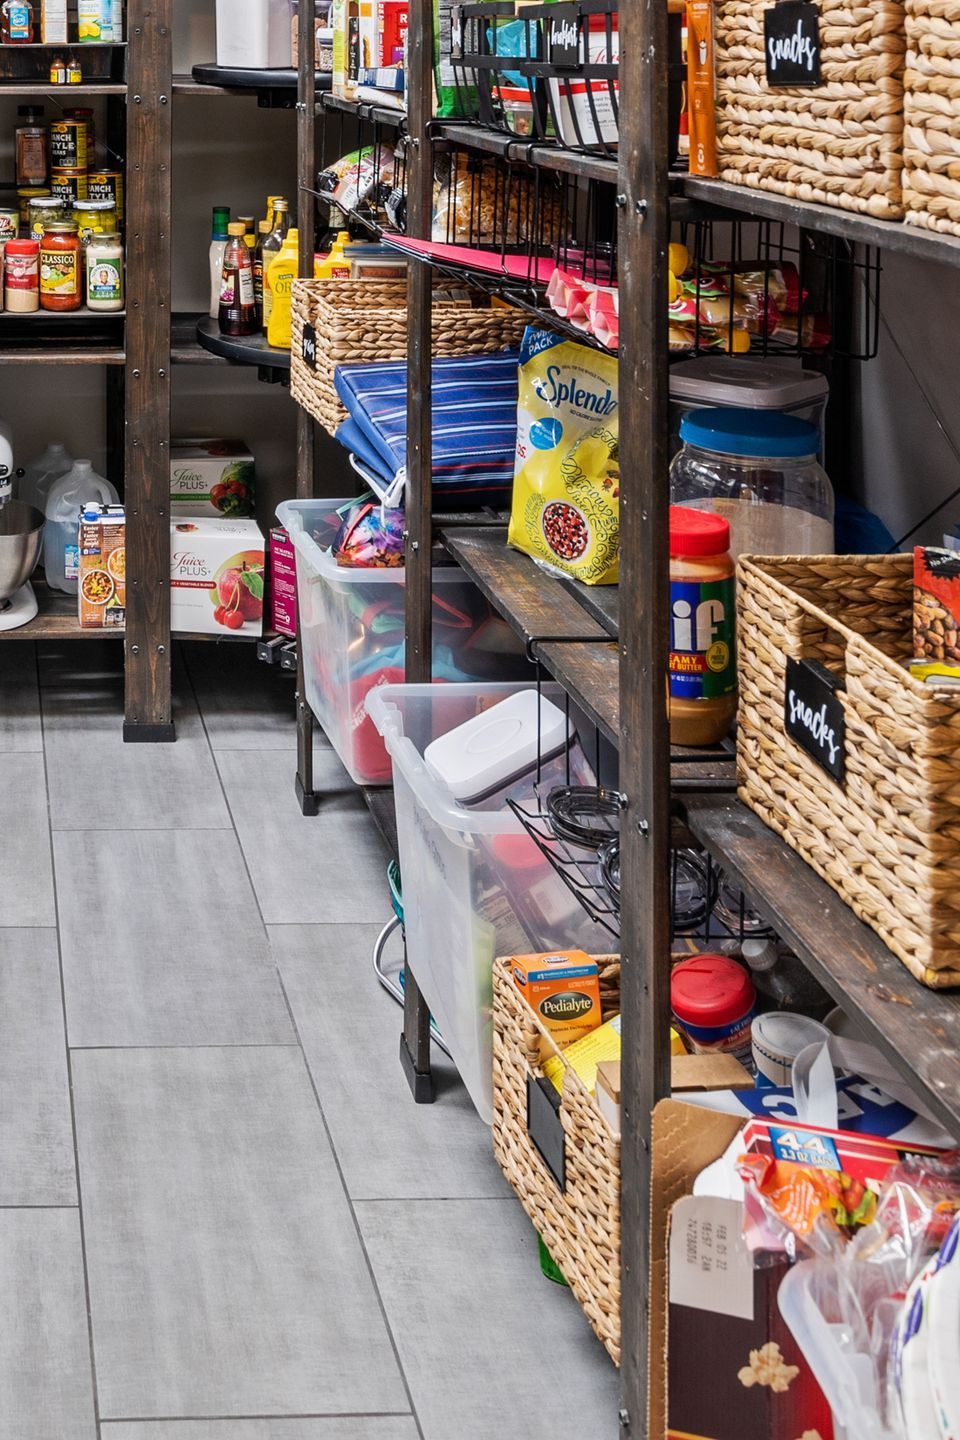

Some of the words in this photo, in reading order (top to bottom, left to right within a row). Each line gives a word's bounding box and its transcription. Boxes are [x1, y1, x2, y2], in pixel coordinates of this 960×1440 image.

[768, 19, 816, 71] snacks
[52, 134, 72, 142] ANCH
[52, 142, 75, 150] TYLE
[52, 186, 73, 194] ANCH
[41, 254, 74, 264] CLASSICO
[528, 335, 554, 356] PACK
[172, 468, 204, 489] Juice
[171, 551, 206, 568] Juice
[672, 600, 726, 651] if
[677, 663, 702, 671] BUTTER
[788, 687, 840, 765] snacks
[543, 998, 592, 1014] Pedialyte
[776, 1131, 828, 1155] 44
[781, 1149, 796, 1160] 3.3
[797, 1150, 808, 1162] OZ
[717, 1224, 727, 1240] FEB
